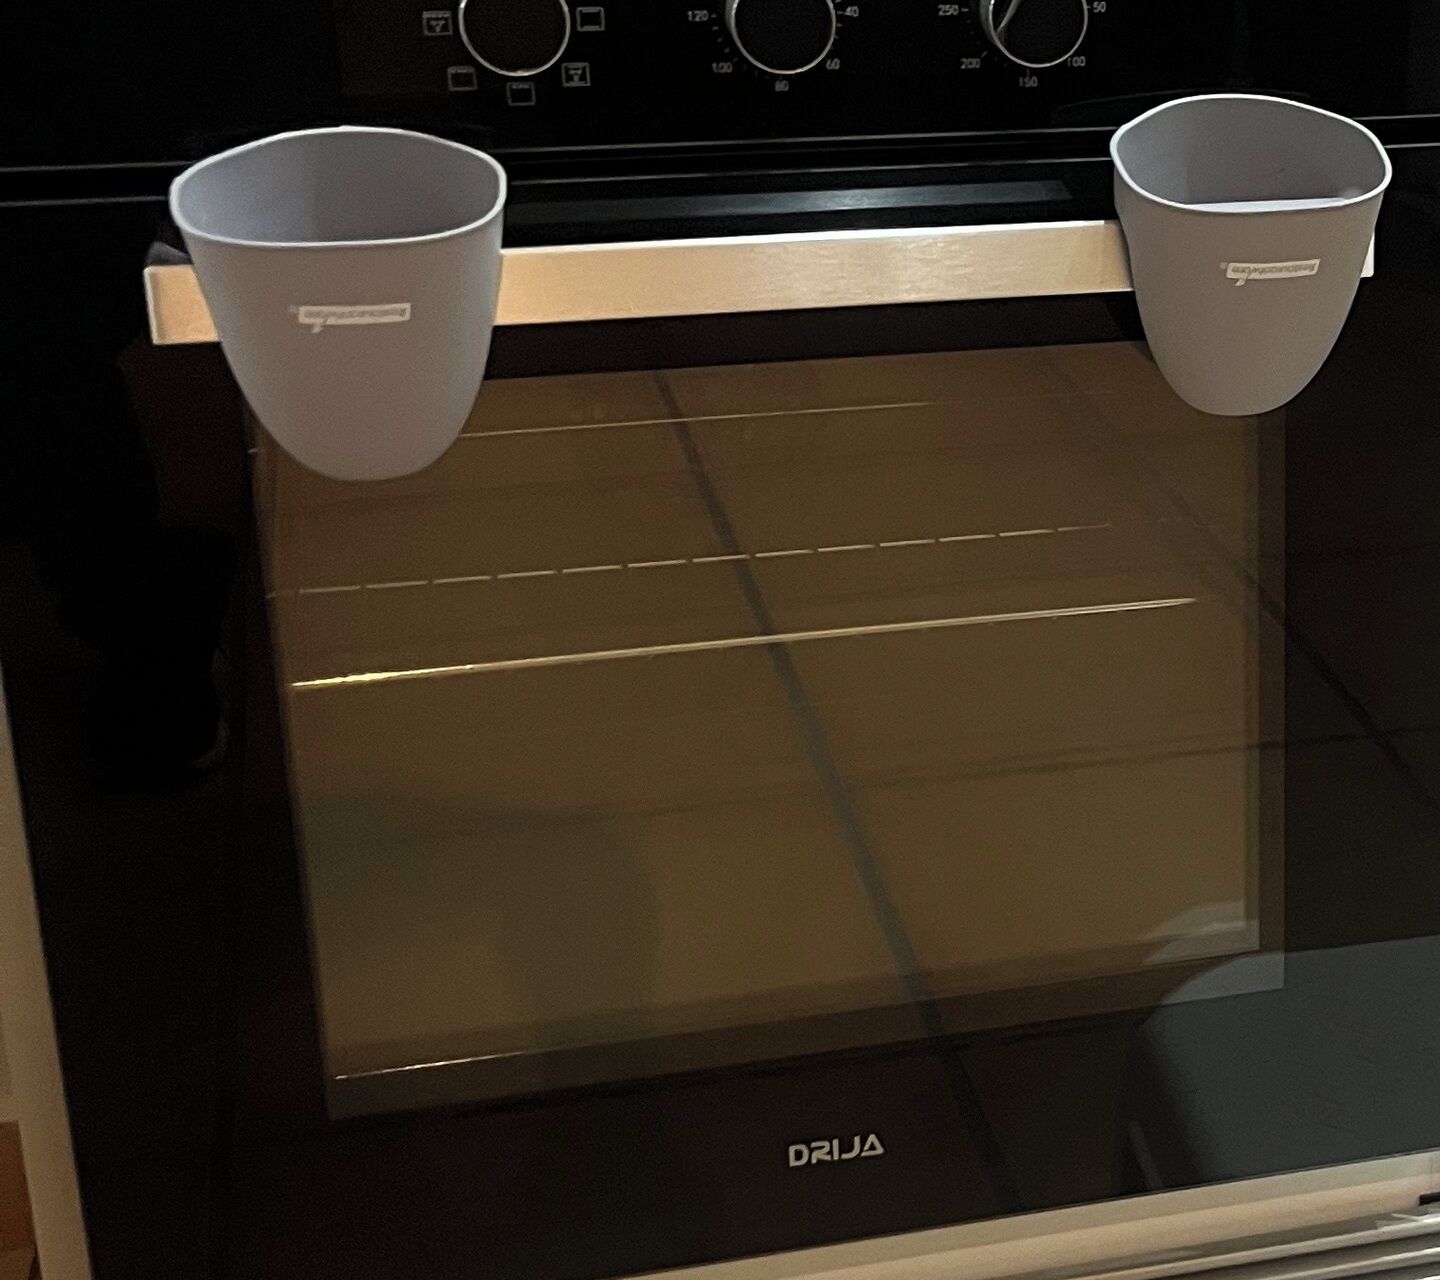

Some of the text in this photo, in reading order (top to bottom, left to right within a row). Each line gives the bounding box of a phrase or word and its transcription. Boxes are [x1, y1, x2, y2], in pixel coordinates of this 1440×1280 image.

[845, 5, 860, 18] 40
[938, 3, 960, 17] 250
[1092, 1, 1107, 14] 50
[687, 9, 709, 22] 120
[712, 61, 733, 74] 100
[826, 58, 841, 71] 60
[960, 57, 981, 70] 200
[1018, 75, 1039, 88] 150
[788, 1133, 886, 1168] DRIJA
